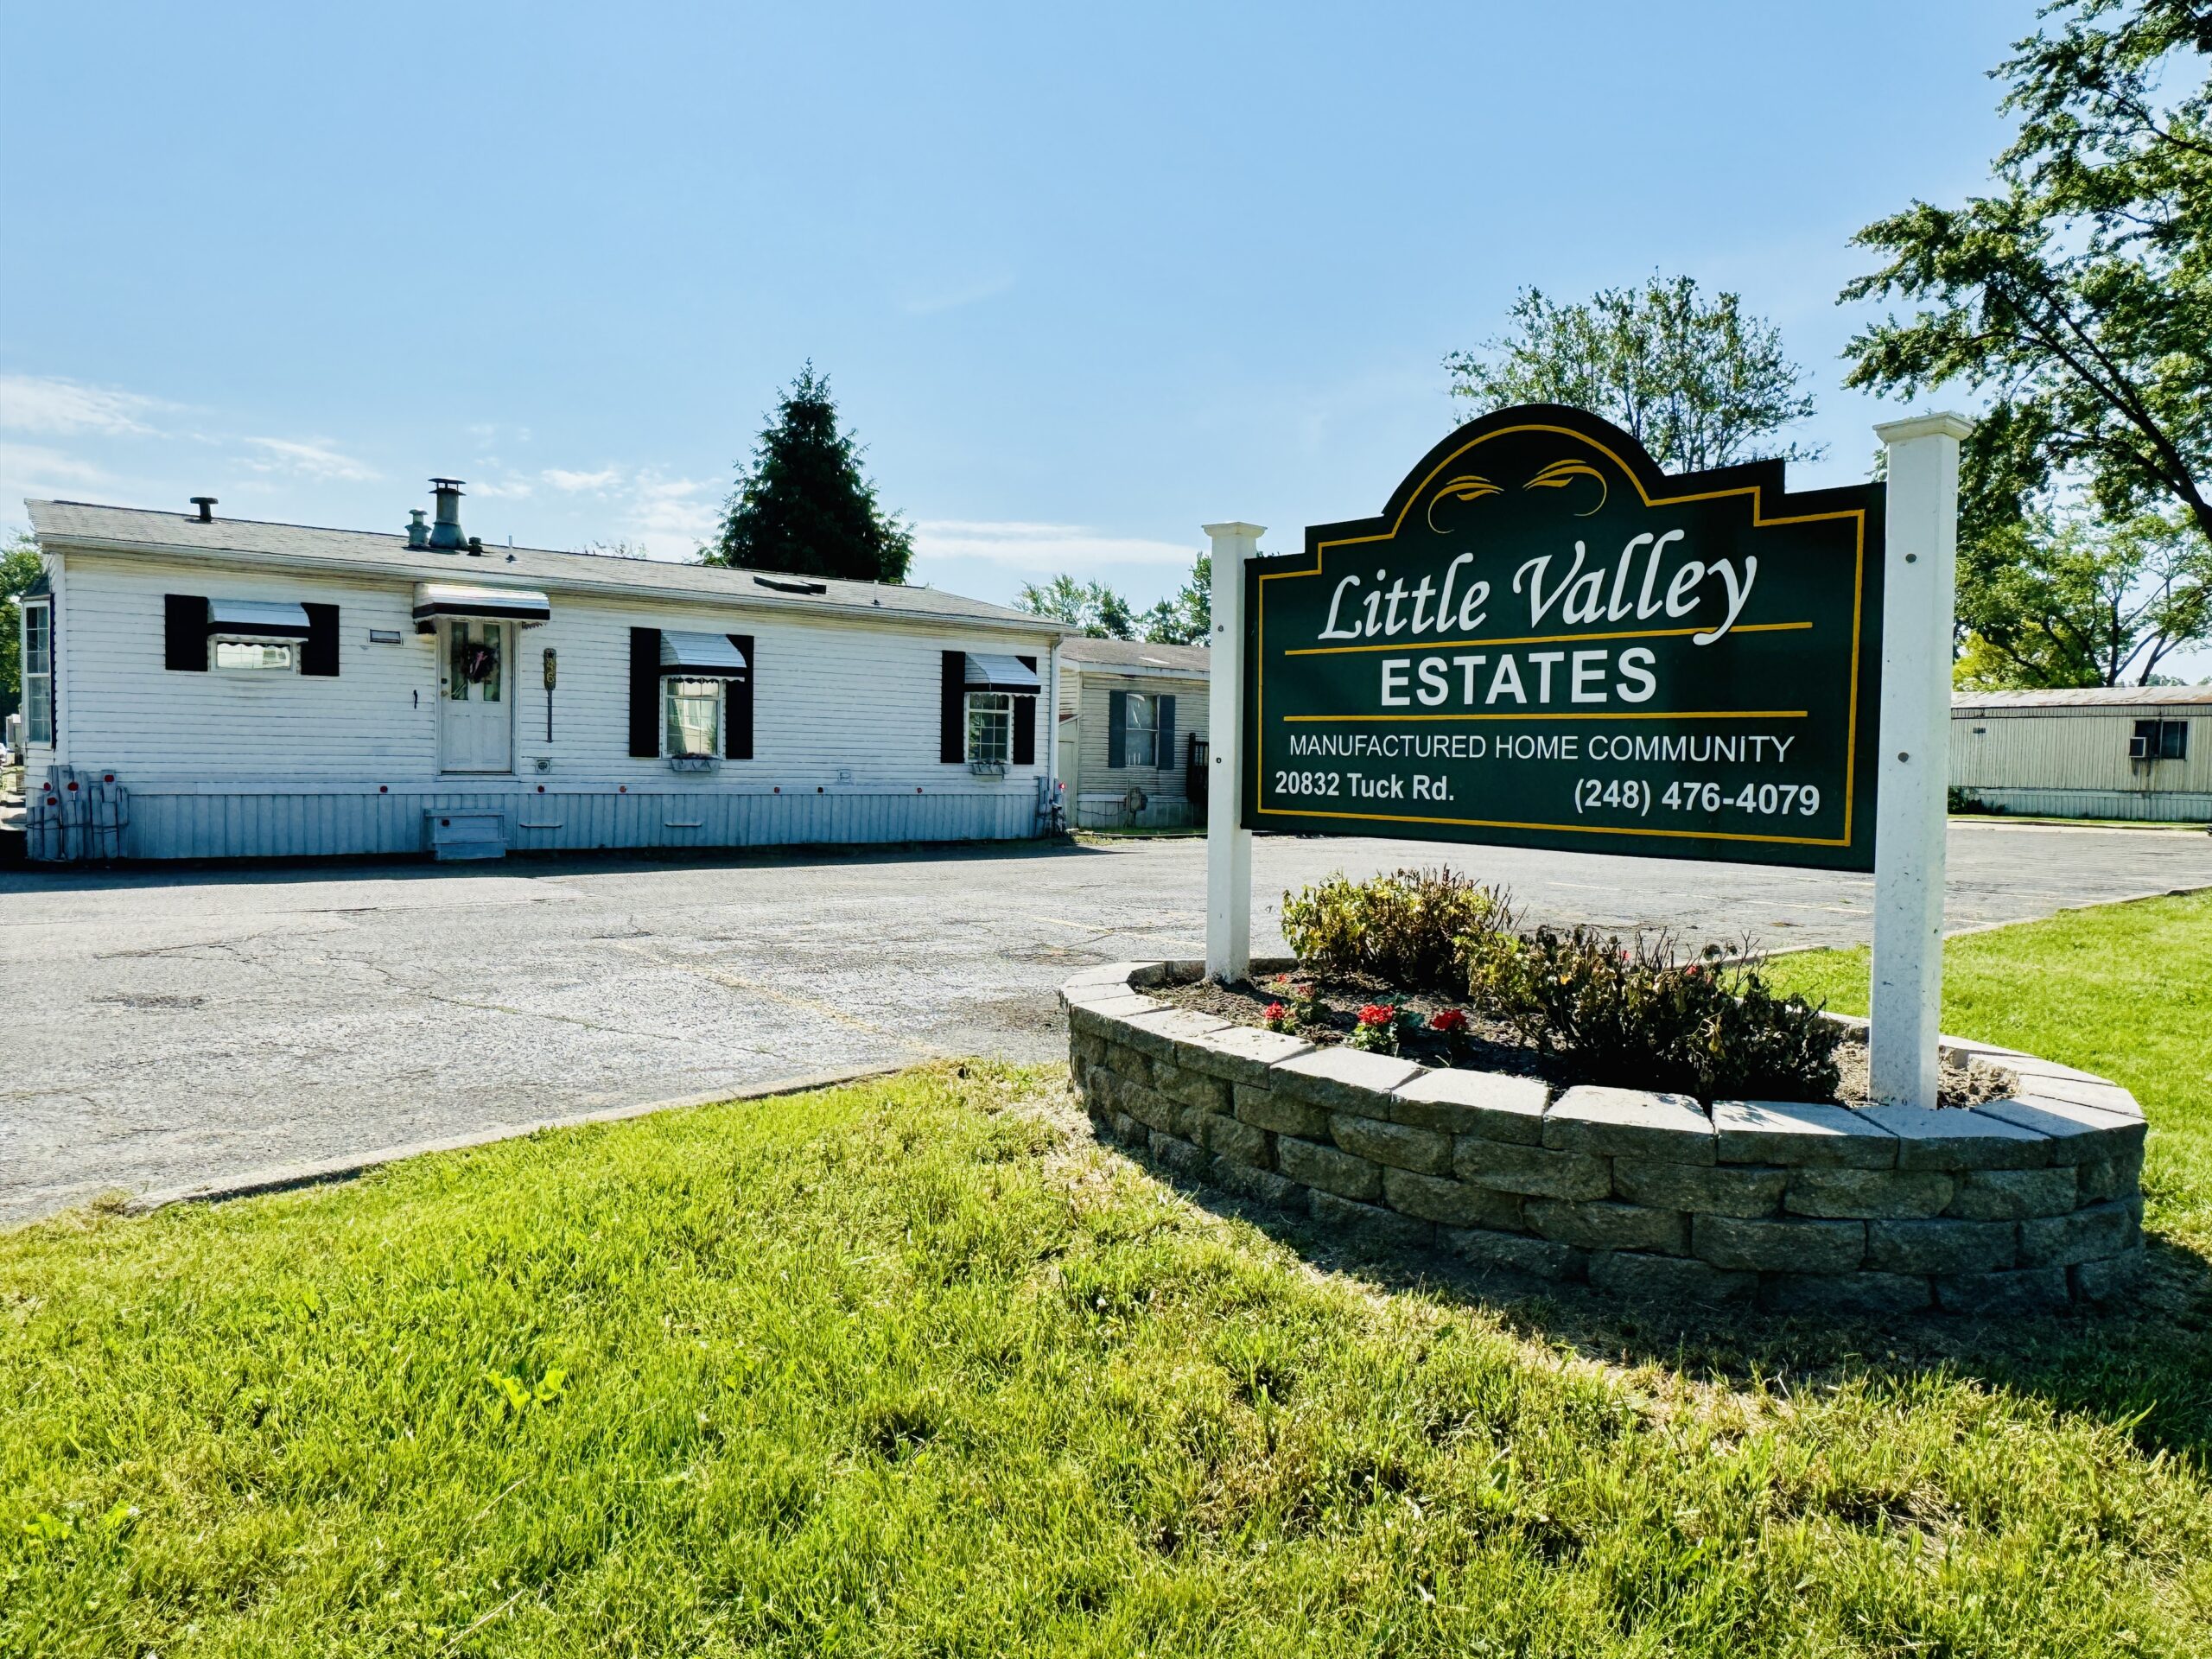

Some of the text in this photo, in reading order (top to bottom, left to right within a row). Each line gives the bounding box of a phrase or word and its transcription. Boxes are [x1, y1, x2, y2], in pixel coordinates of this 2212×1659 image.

[1319, 530, 1758, 645] Little Valley
[1381, 648, 1656, 706] ESTATES
[1290, 734, 1795, 763] MANUFACTURED HOME COMMUNITY
[1274, 771, 1454, 801] 20832 Tuck Rd.
[1574, 779, 1821, 817] (248) 476-4079
